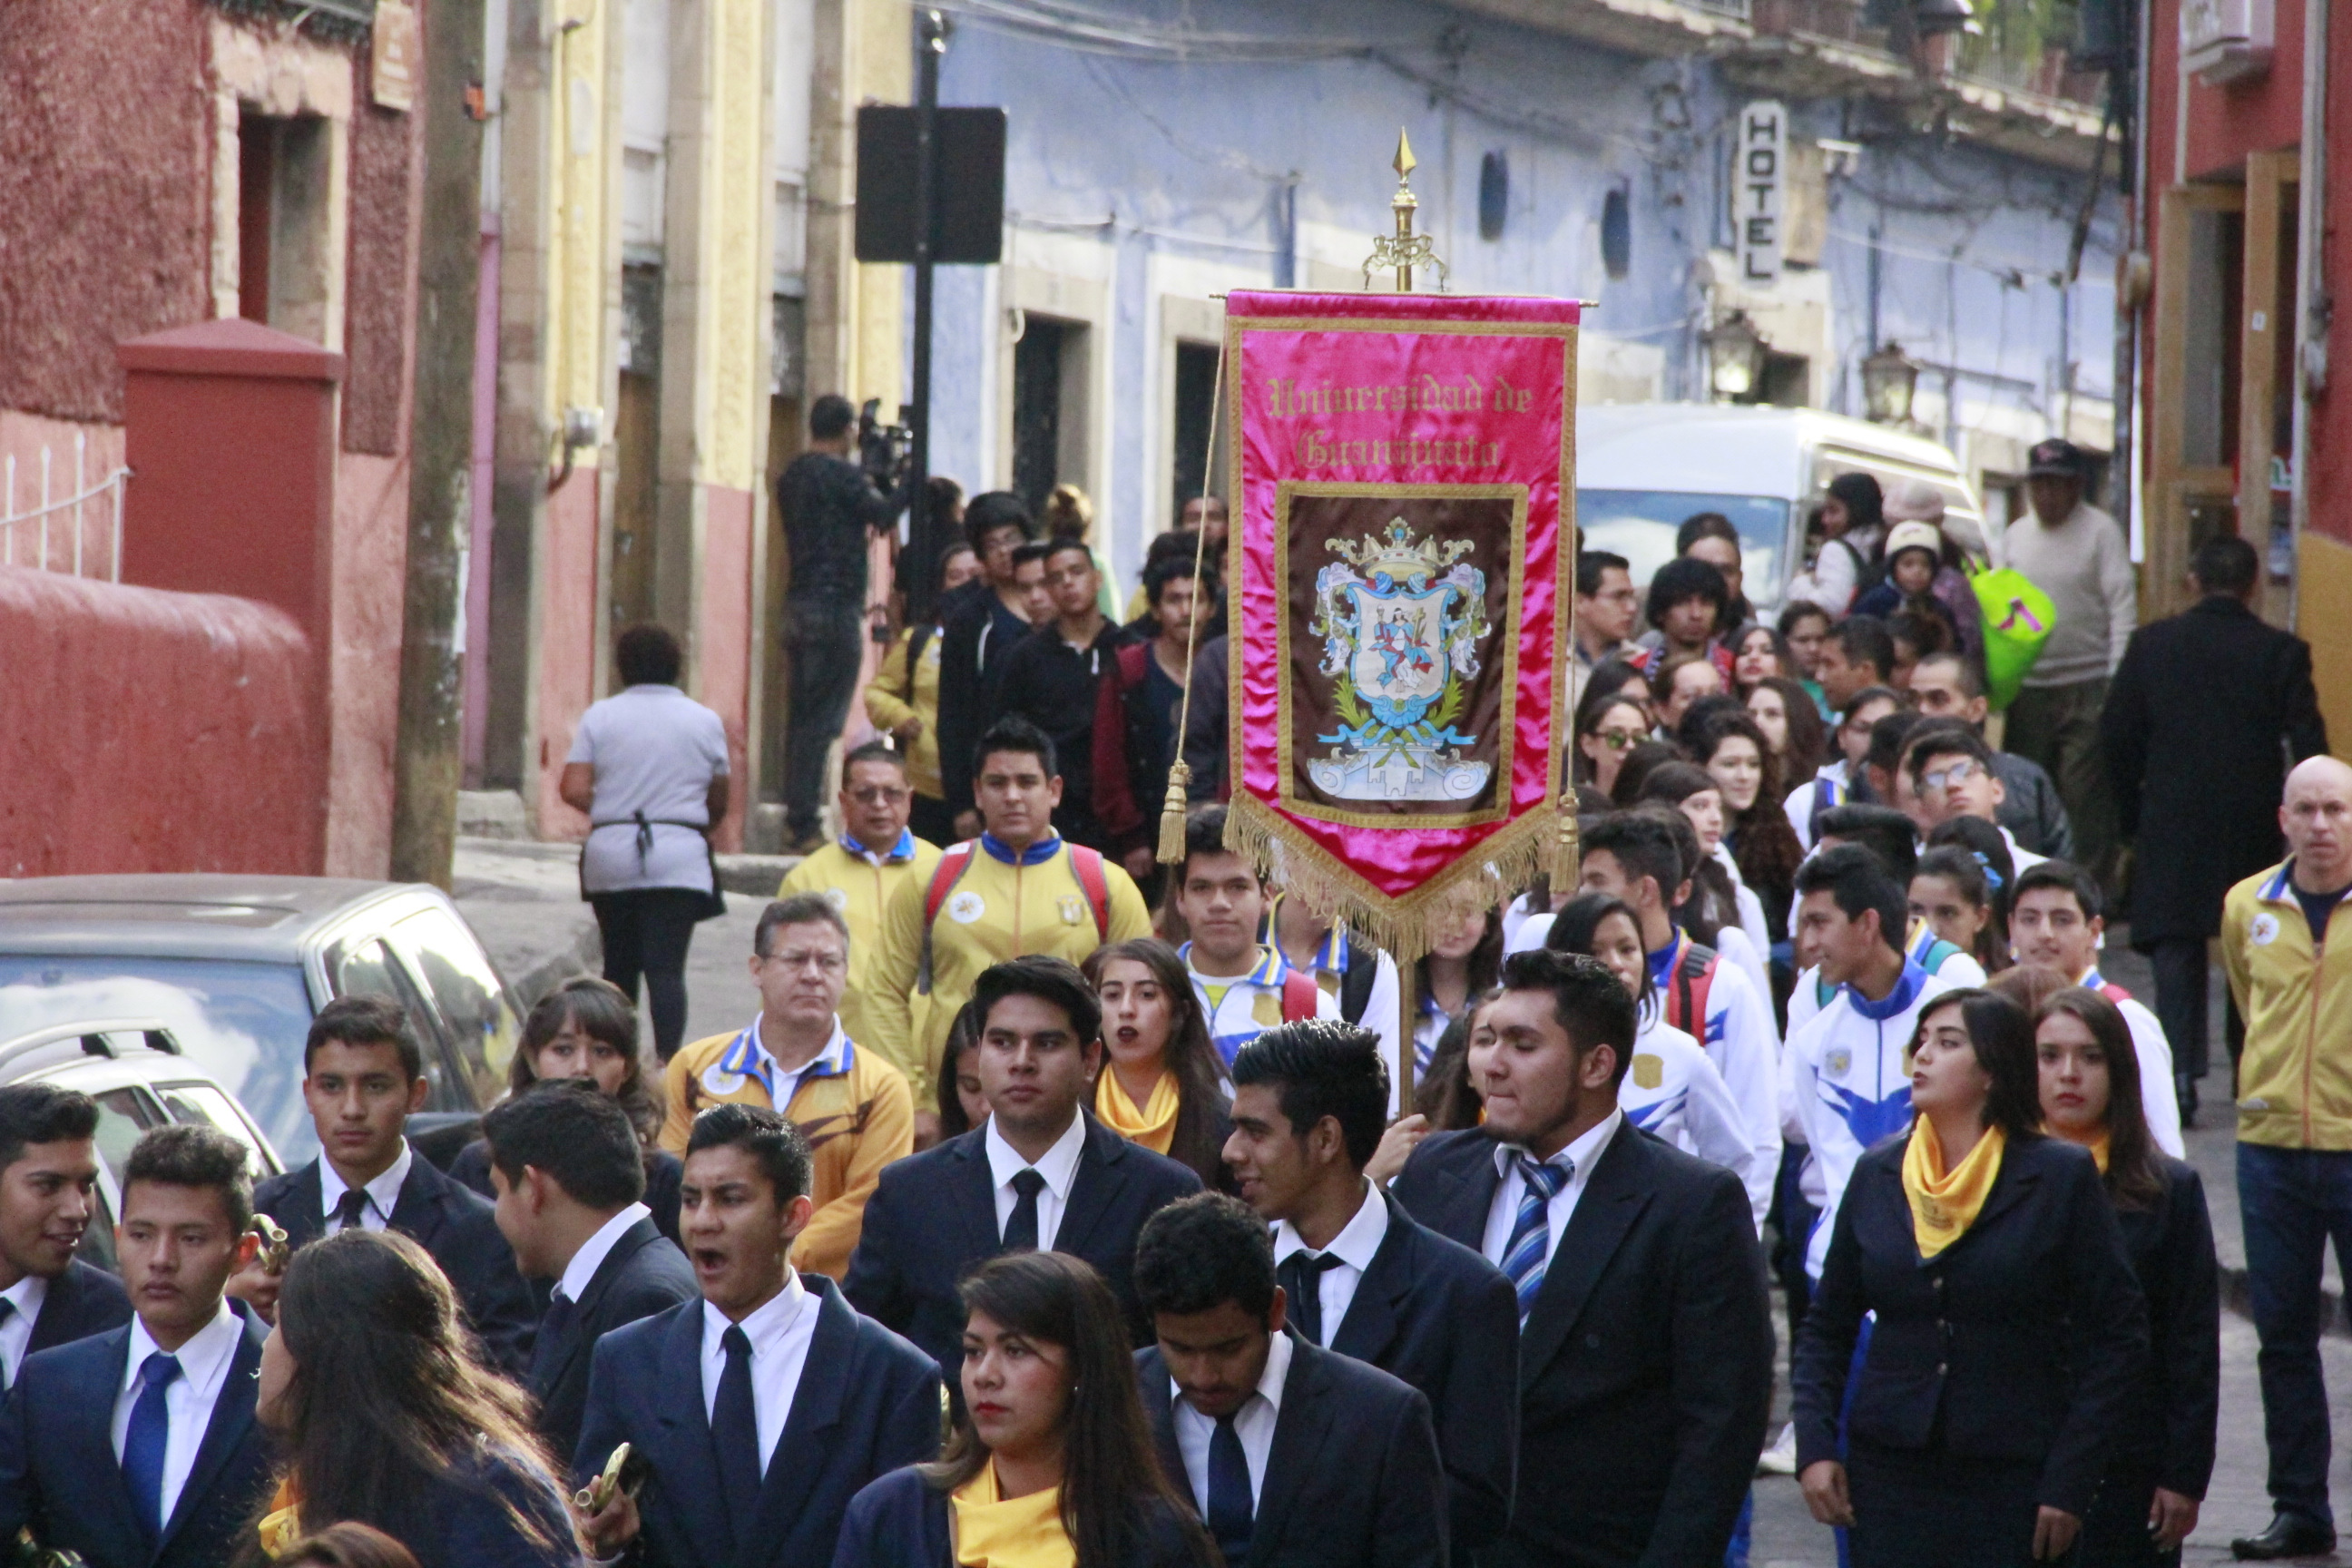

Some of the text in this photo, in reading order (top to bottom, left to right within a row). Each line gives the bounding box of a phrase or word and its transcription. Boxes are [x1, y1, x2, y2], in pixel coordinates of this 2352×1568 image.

[1746, 113, 1777, 279] HOTEL
[1267, 373, 1534, 417] Universidad de
